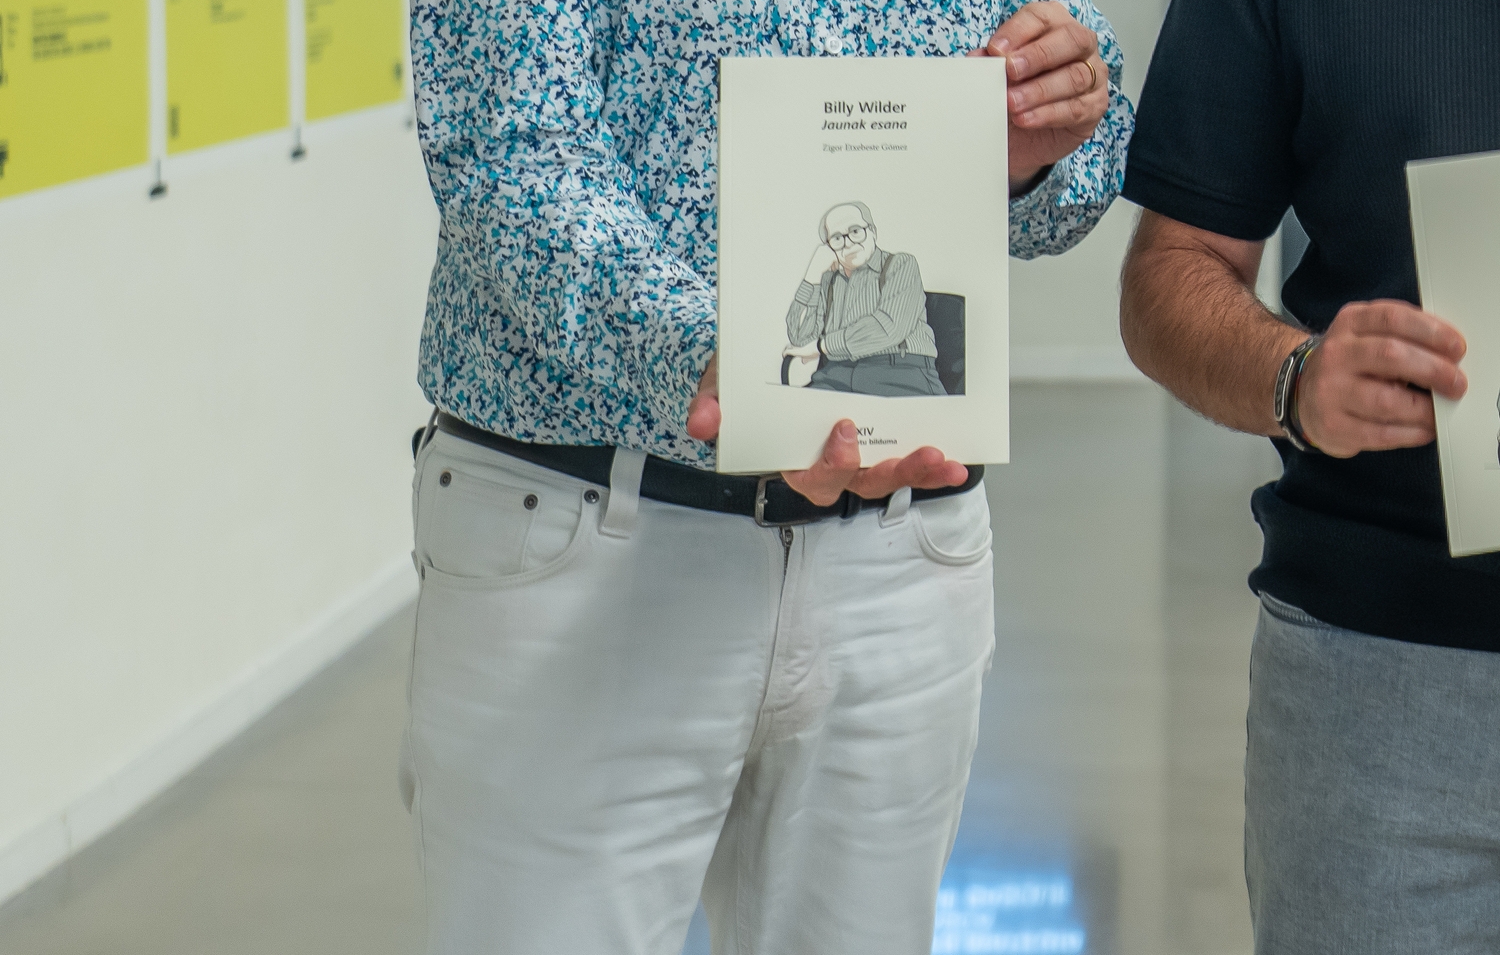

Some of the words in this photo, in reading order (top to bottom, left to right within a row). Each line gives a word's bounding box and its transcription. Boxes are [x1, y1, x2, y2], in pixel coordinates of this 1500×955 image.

[824, 100, 854, 117] Billy
[859, 100, 907, 113] Wilder
[822, 119, 867, 130] Jaunak
[871, 121, 907, 130] esana
[823, 143, 842, 153] Zigor
[845, 143, 879, 151] Etxebeste
[881, 143, 908, 151] Gómez
